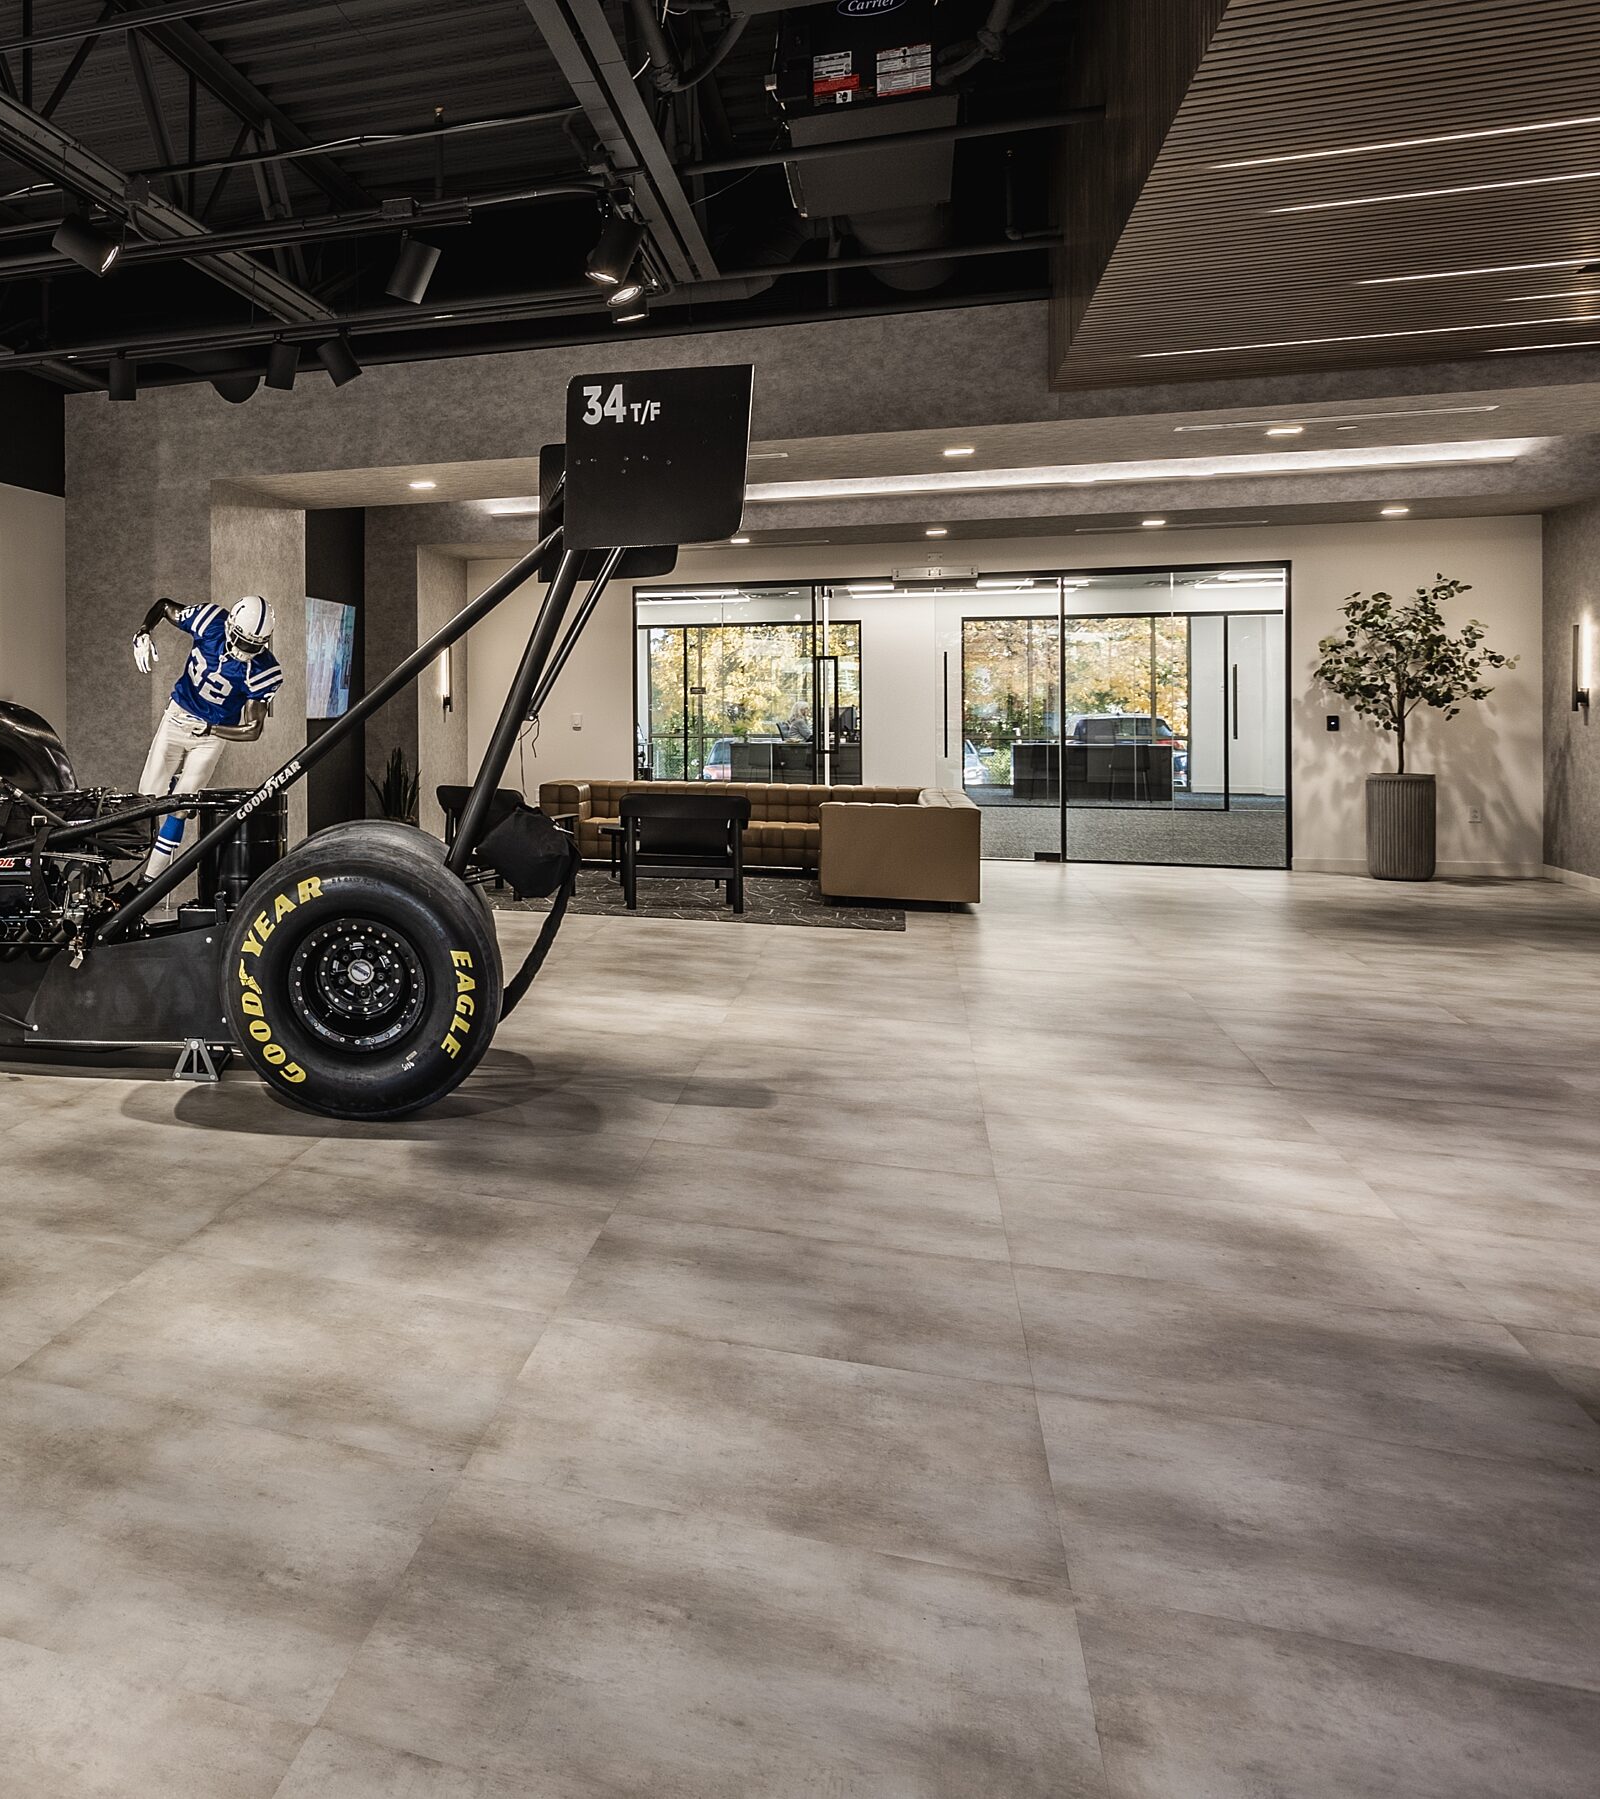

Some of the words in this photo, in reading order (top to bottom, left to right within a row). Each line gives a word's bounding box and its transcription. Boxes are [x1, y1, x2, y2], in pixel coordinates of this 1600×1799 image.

[582, 384, 627, 425] 34
[630, 400, 661, 425] T/F
[188, 647, 233, 705] 32
[441, 950, 476, 1059] EAGLE
